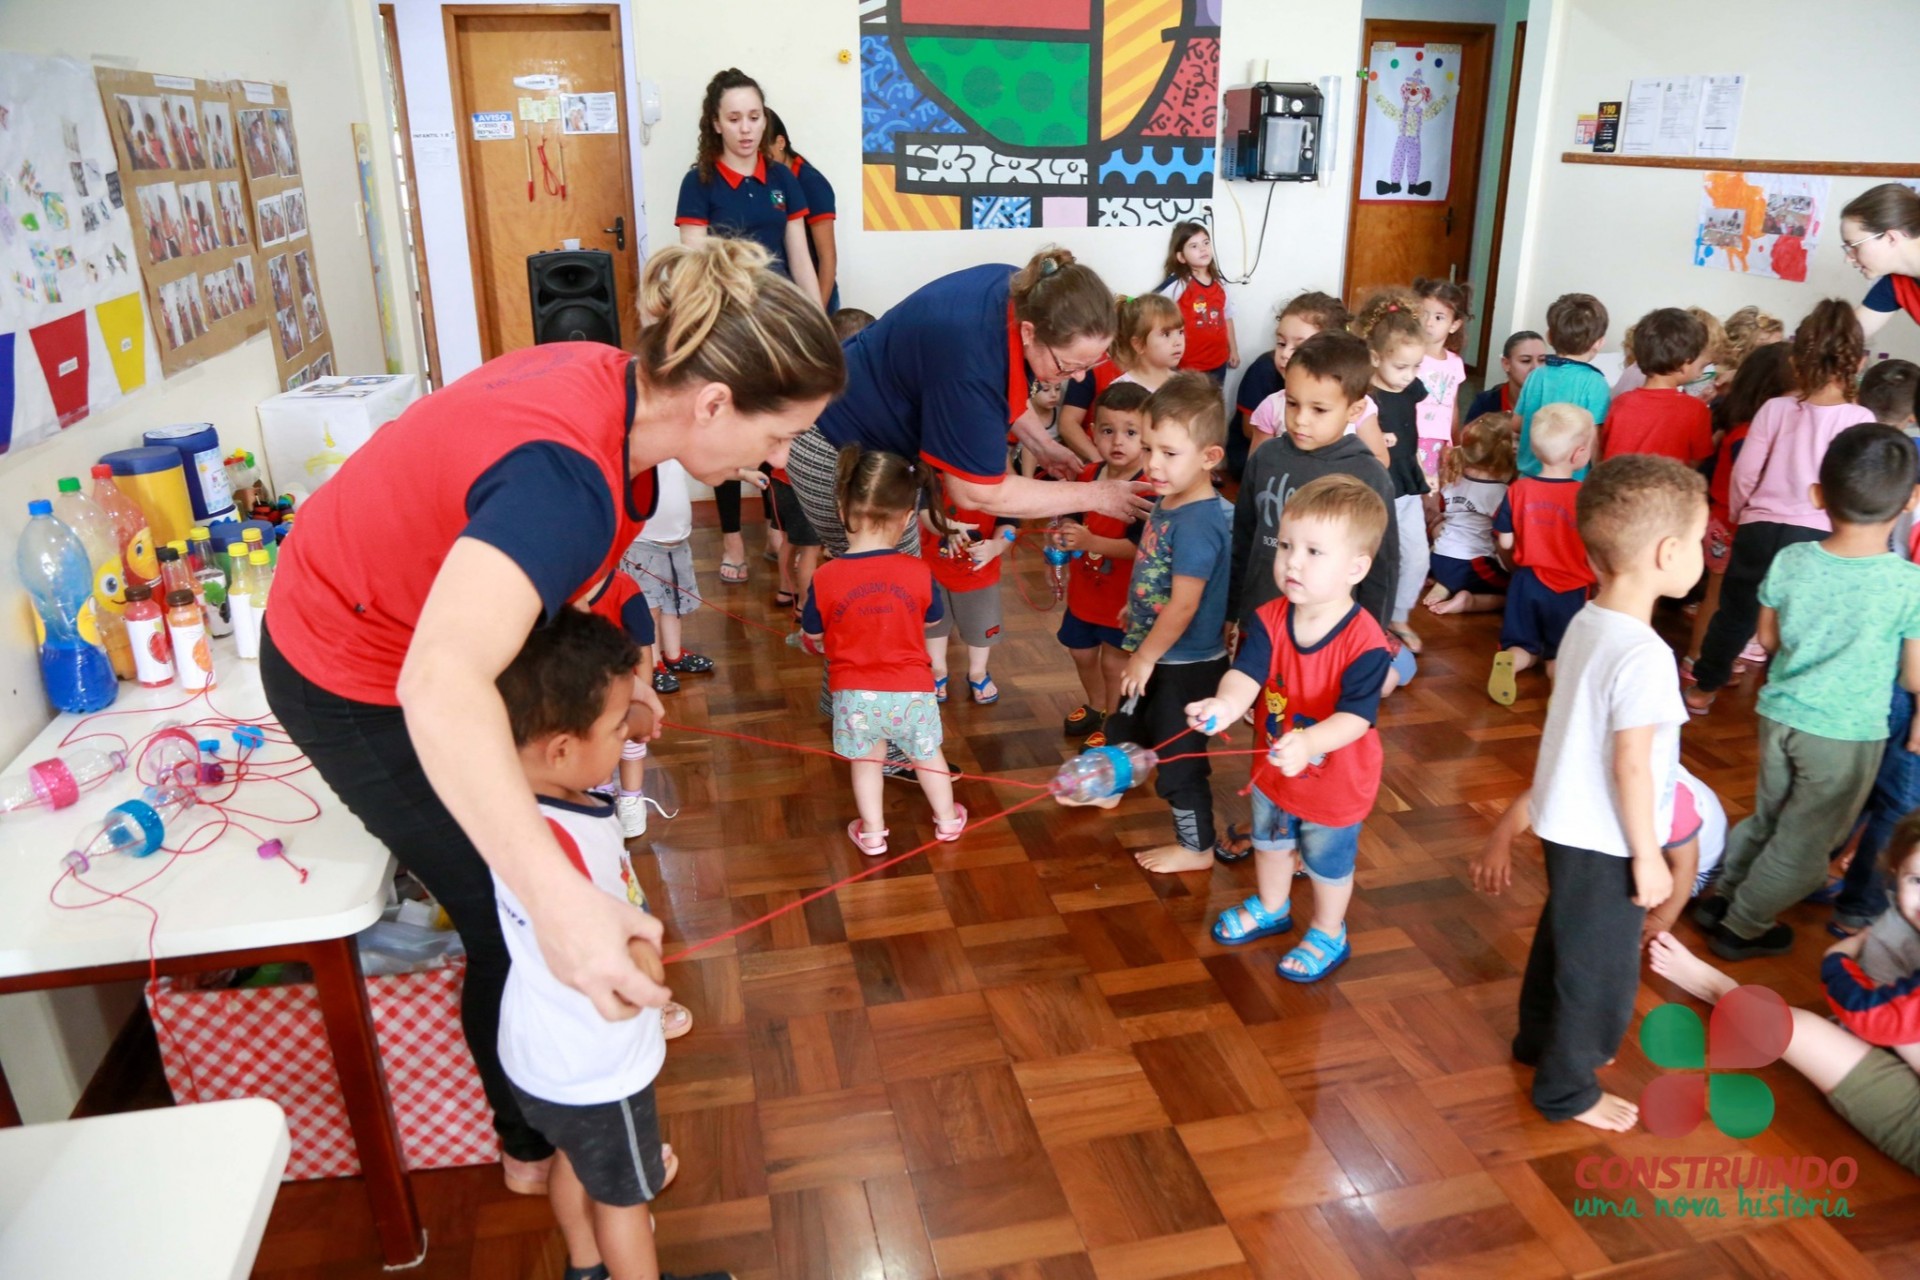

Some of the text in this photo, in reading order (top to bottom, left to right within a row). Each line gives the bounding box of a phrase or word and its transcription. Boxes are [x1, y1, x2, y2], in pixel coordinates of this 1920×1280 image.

[478, 113, 508, 122] AVISO
[1255, 473, 1296, 528] He
[1262, 535, 1279, 548] BOR
